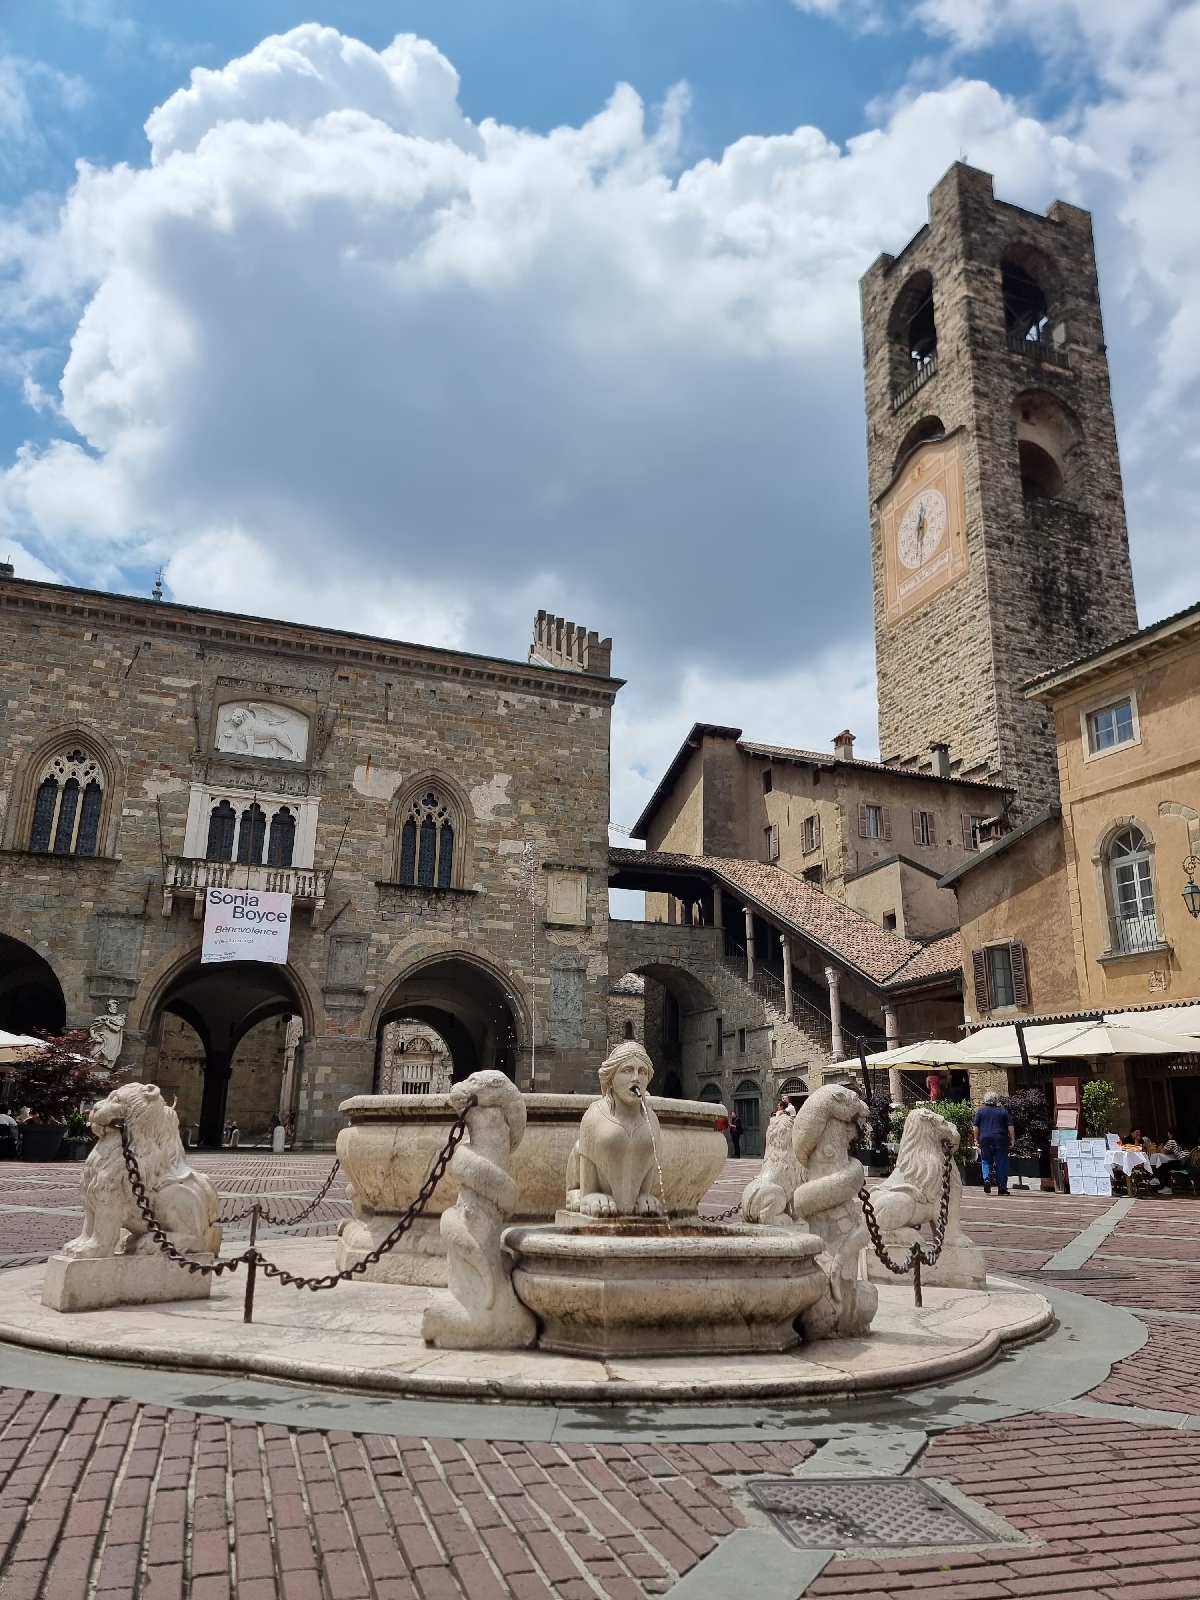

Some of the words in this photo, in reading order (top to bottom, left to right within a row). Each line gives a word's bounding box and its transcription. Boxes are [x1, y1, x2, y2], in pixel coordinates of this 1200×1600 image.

[209, 890, 259, 906] Sonia
[232, 906, 287, 923] Boyce
[215, 925, 278, 935] Benevolence
